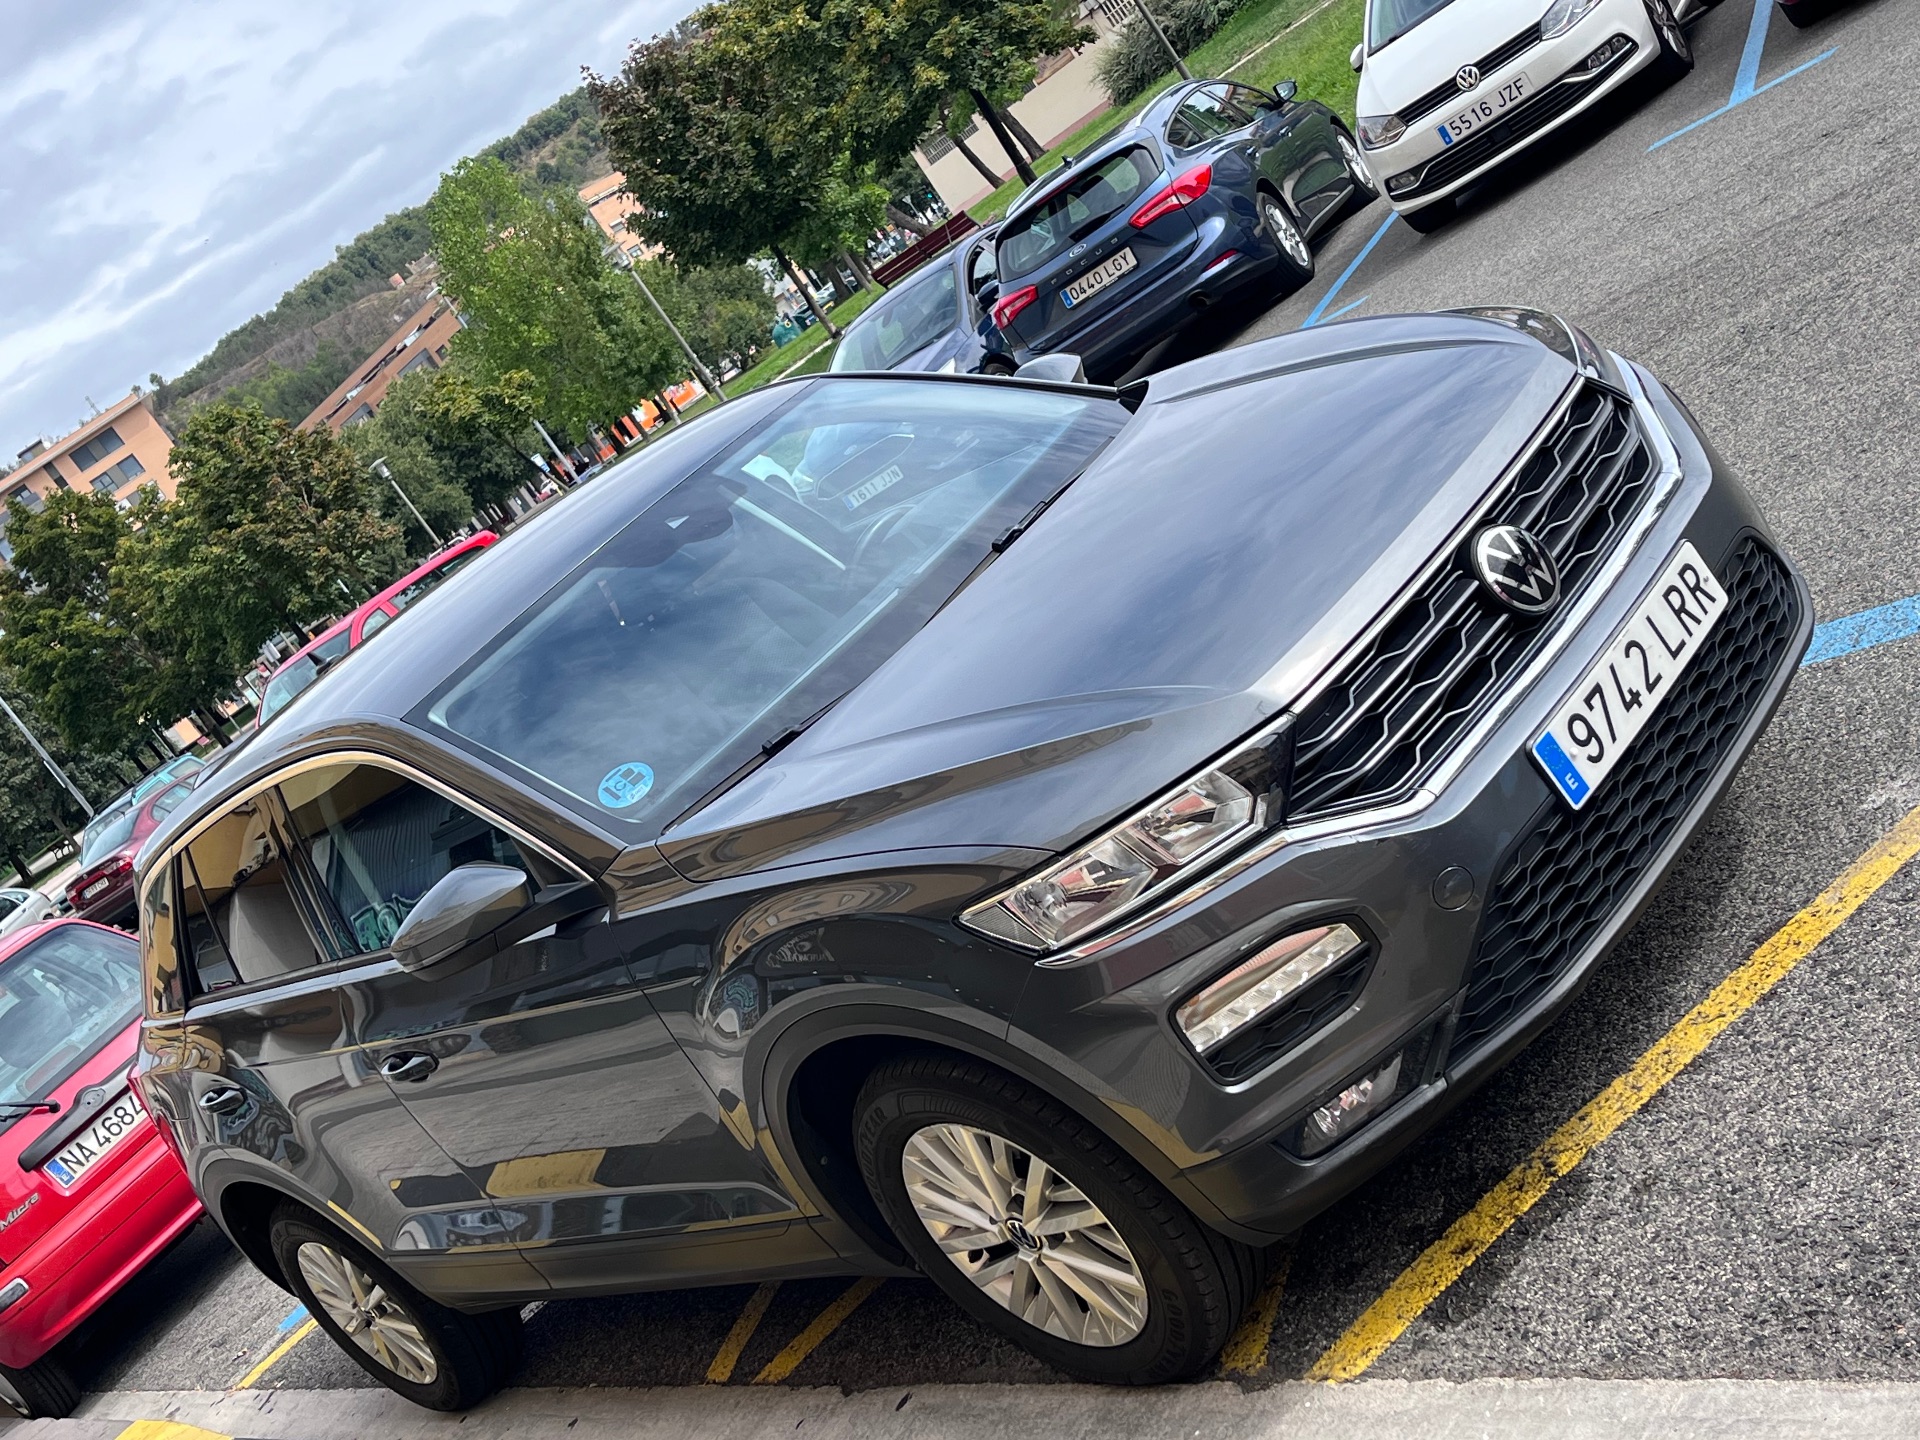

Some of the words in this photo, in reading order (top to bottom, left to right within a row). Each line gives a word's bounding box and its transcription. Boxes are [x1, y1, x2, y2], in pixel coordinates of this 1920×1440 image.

[1449, 101, 1493, 136] 5516
[1498, 77, 1524, 108] JZF
[1069, 271, 1103, 301] 0440
[1103, 252, 1130, 278] LGY
[852, 482, 879, 504] 1611
[880, 467, 901, 488] JJN
[1567, 639, 1663, 764] 9742
[1645, 562, 1717, 661] LRR
[1564, 771, 1580, 791] E
[59, 1141, 98, 1175] NA
[0, 1192, 39, 1232] Micra
